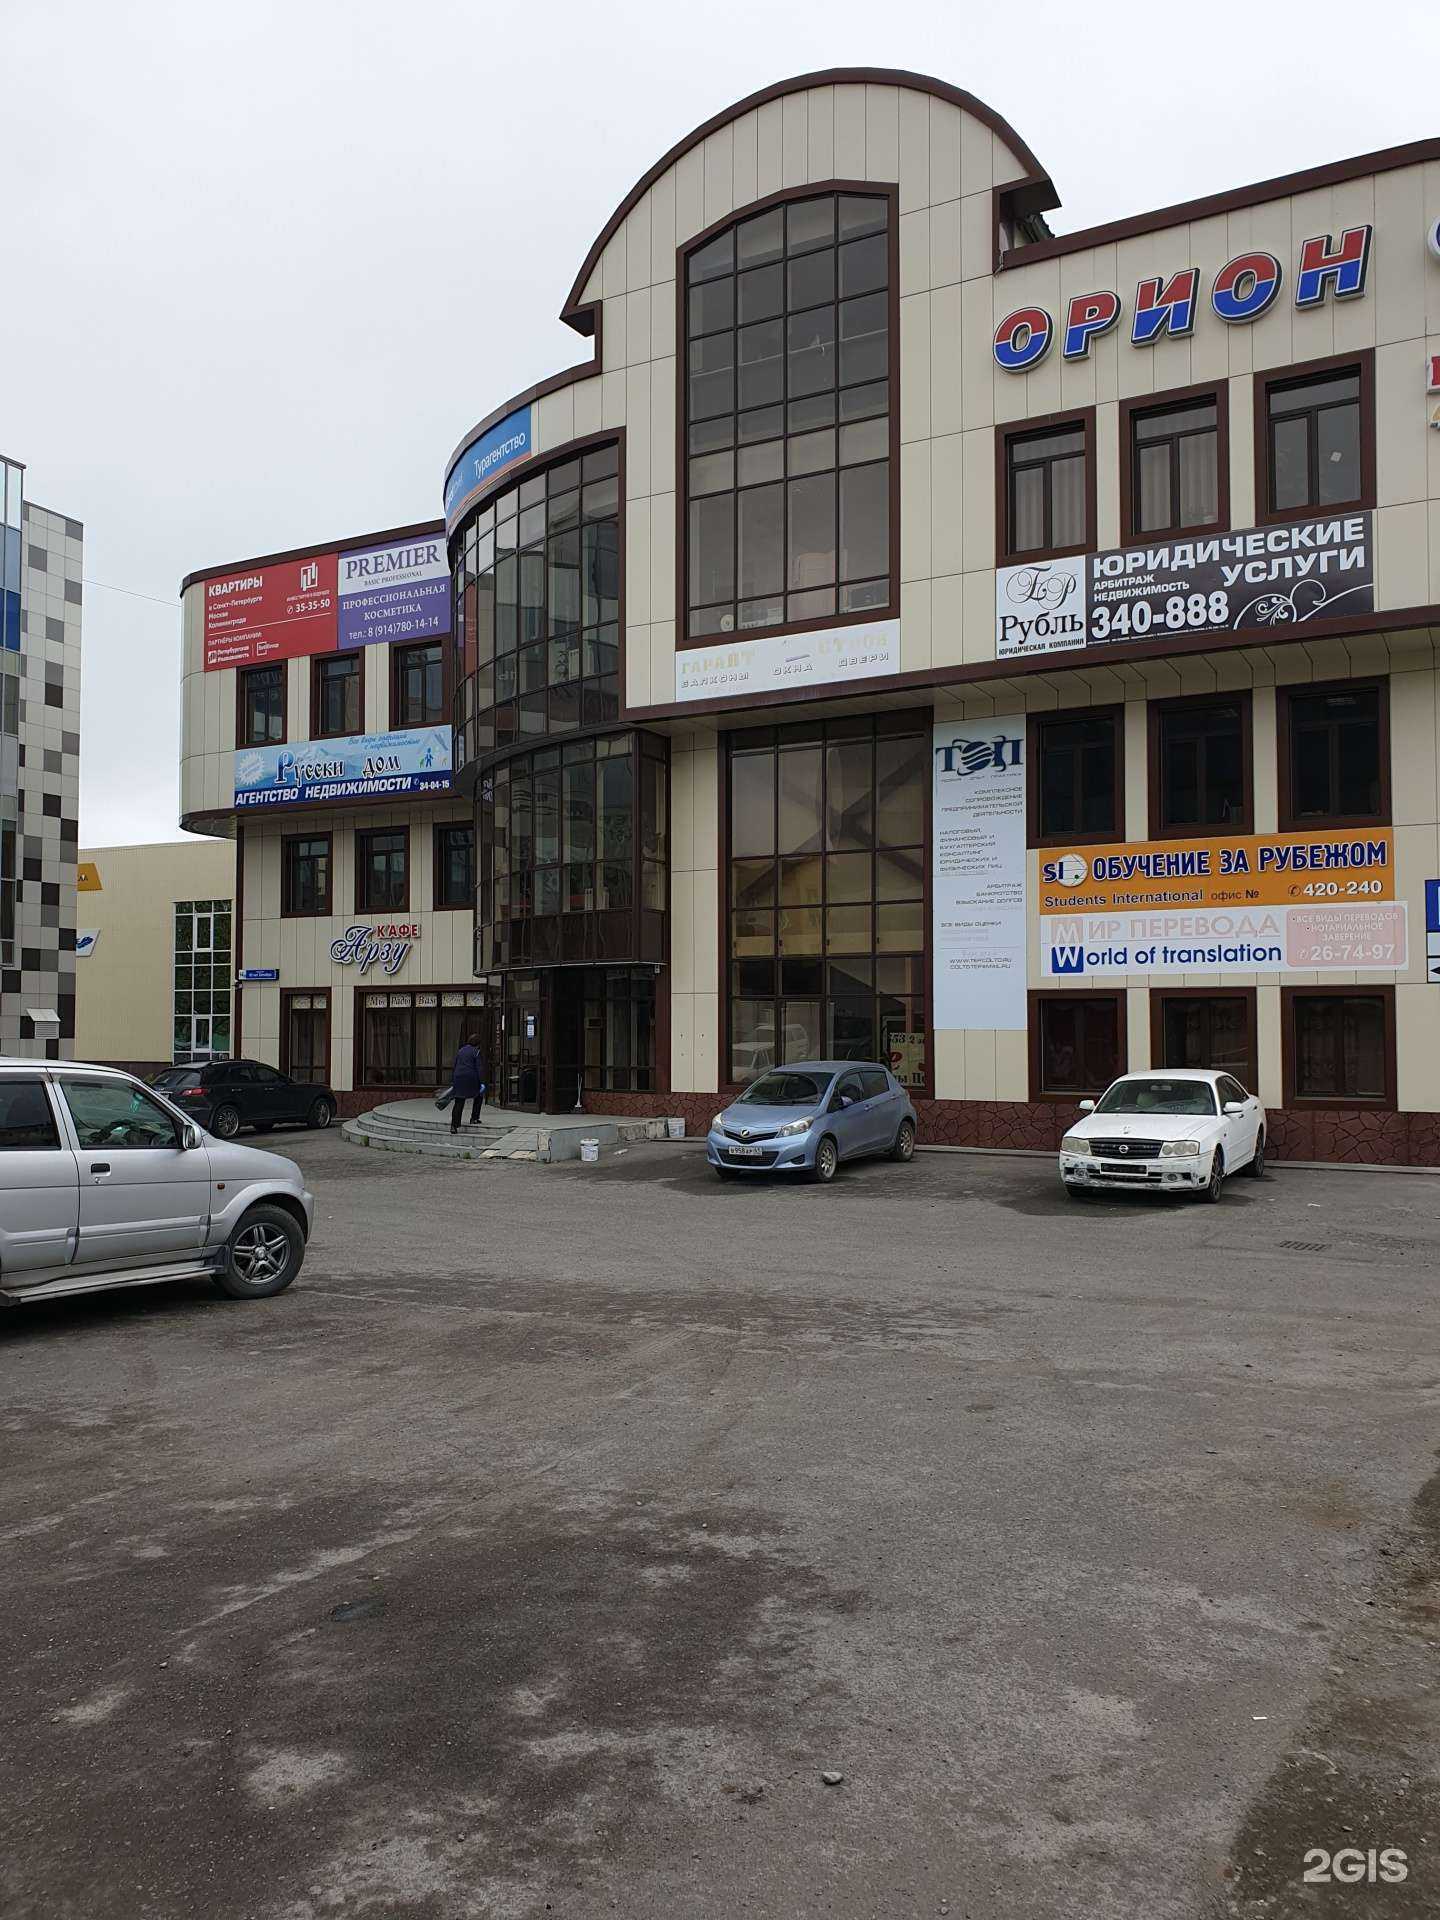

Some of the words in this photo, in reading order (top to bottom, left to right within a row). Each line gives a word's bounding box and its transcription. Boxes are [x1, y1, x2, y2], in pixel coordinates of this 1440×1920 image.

[992, 224, 1374, 374] ОРИОН
[473, 433, 526, 479] Турагентство
[1093, 517, 1364, 579] ЮРИДИЧЕСКИЕ
[345, 544, 440, 579] PREMIER
[1221, 545, 1365, 587] УСЛУГИ
[208, 576, 263, 597] КВАРТИРЫ
[1093, 574, 1155, 591] АРБИТРАЖ
[1094, 581, 1190, 602] НЕДВИЖИМОСТЬ
[295, 599, 331, 613] 35-35-50
[343, 584, 446, 610] ПРОФЕССИОНАЛЬНАЯ
[364, 603, 422, 620] КОСМЕТИКА
[1091, 590, 1229, 639] 340-888
[367, 627, 374, 637] 8
[374, 616, 439, 637] (914)780-14-14
[1000, 611, 1084, 644] Рубль
[999, 643, 1046, 656] ЮРИДИЧЕСКАЯ
[1049, 638, 1084, 649] КОМПАНИЯ
[681, 672, 749, 689] БАЛКОНЫ
[772, 663, 813, 676] ОКНА
[837, 652, 889, 667] ДВЕРИ
[235, 788, 298, 805] АГЕНТСТВО
[305, 777, 411, 800] НЕДВИЖИМОСТИ
[420, 780, 450, 791] 34-04-15
[1092, 850, 1212, 881] ОБУЧЕНИЕ
[1219, 849, 1249, 875] ЗА
[1258, 840, 1387, 871] РУБЕЖОМ
[1044, 894, 1107, 907] Students
[1113, 889, 1203, 904] International
[1211, 889, 1242, 902] офис
[1245, 888, 1260, 899] №
[1303, 880, 1382, 897] 420-240
[1130, 913, 1280, 938] ПЕРЕВОДА
[1311, 922, 1383, 931] НОТАРИАЛЬНОЕ
[1315, 913, 1342, 923] ВИДЫ
[1344, 912, 1399, 921] ПЕРЕВОДОВ
[377, 924, 419, 938] КАФЕ
[330, 925, 411, 975] Арзу
[1053, 946, 1128, 969] World
[1135, 947, 1156, 965] of
[1162, 944, 1281, 964] translation
[1311, 944, 1395, 961] 26-74-97
